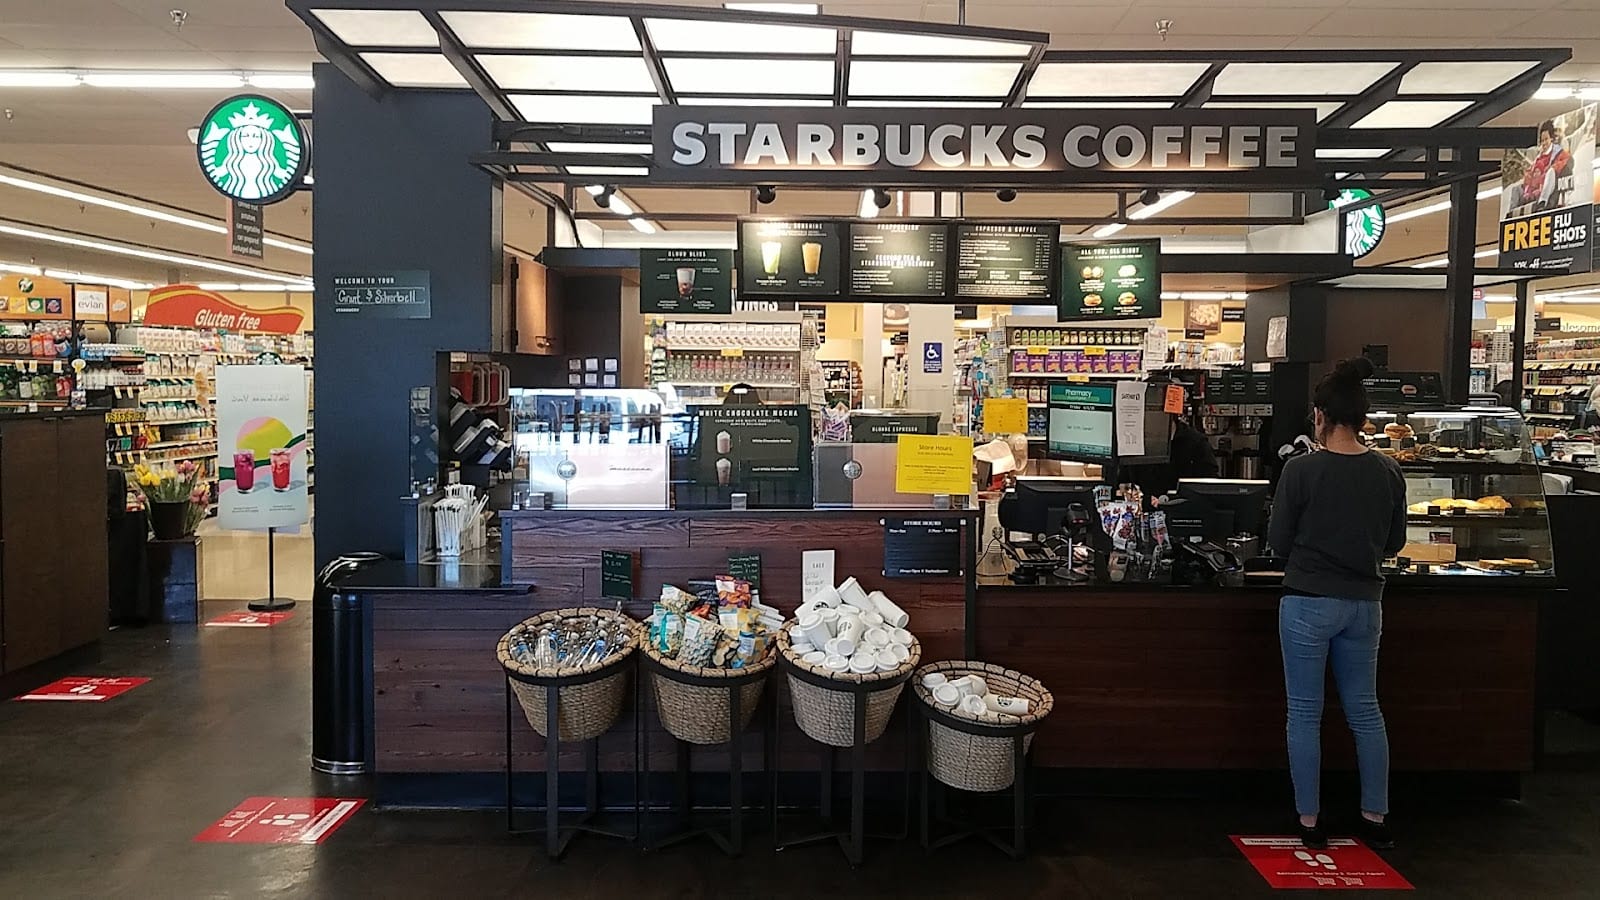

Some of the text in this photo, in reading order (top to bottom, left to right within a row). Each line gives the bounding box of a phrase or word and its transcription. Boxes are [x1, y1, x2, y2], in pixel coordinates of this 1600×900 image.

[671, 122, 1299, 170] STARBUCKS COFFEE
[1554, 213, 1572, 228] FLU
[1503, 216, 1552, 252] FREE
[1553, 225, 1587, 243] SHOTS
[78, 301, 104, 310] evian
[195, 309, 261, 330] Gluten free
[1065, 389, 1092, 397] Pharmacy
[935, 444, 952, 452] Hours
